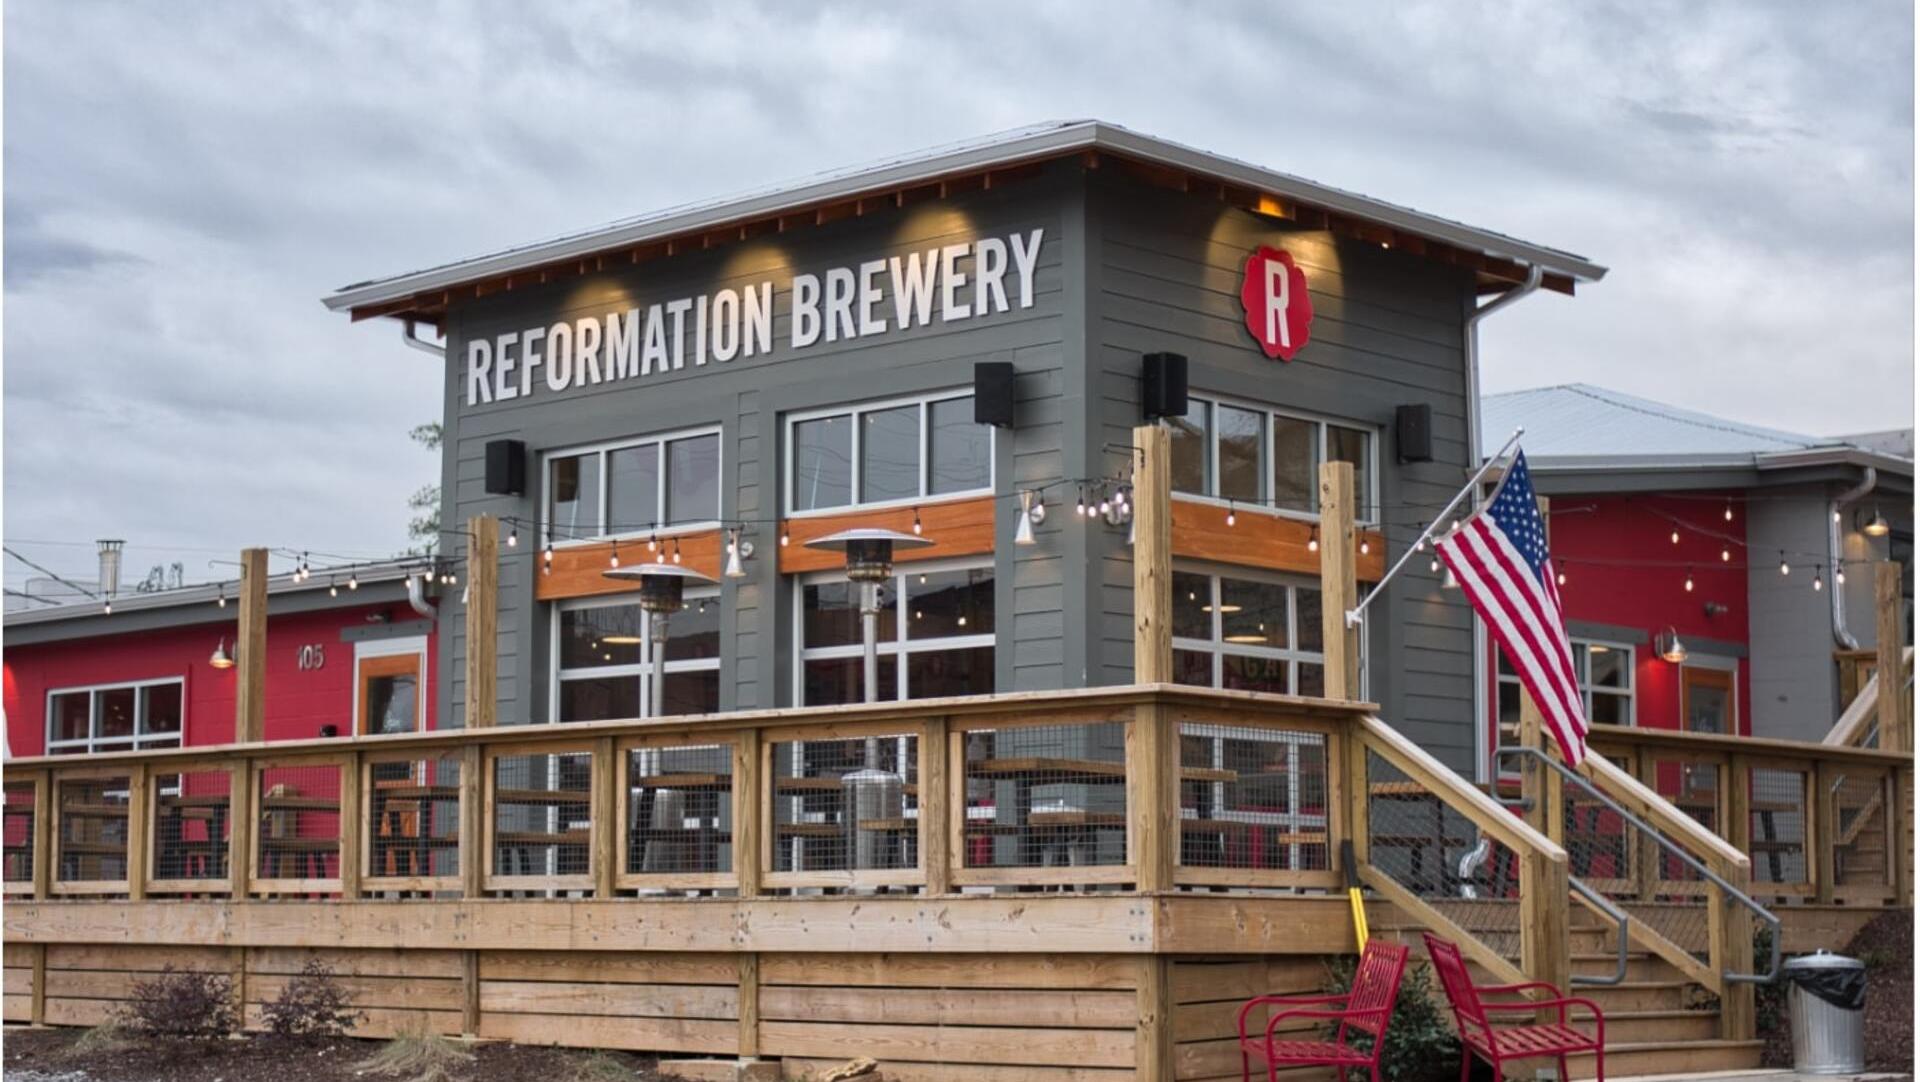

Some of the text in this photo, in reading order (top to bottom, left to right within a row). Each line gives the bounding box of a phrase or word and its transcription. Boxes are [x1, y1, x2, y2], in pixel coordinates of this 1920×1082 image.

[467, 228, 1044, 406] REFORMATION BREWERY
[1265, 258, 1291, 348] R
[297, 643, 324, 670] 105
